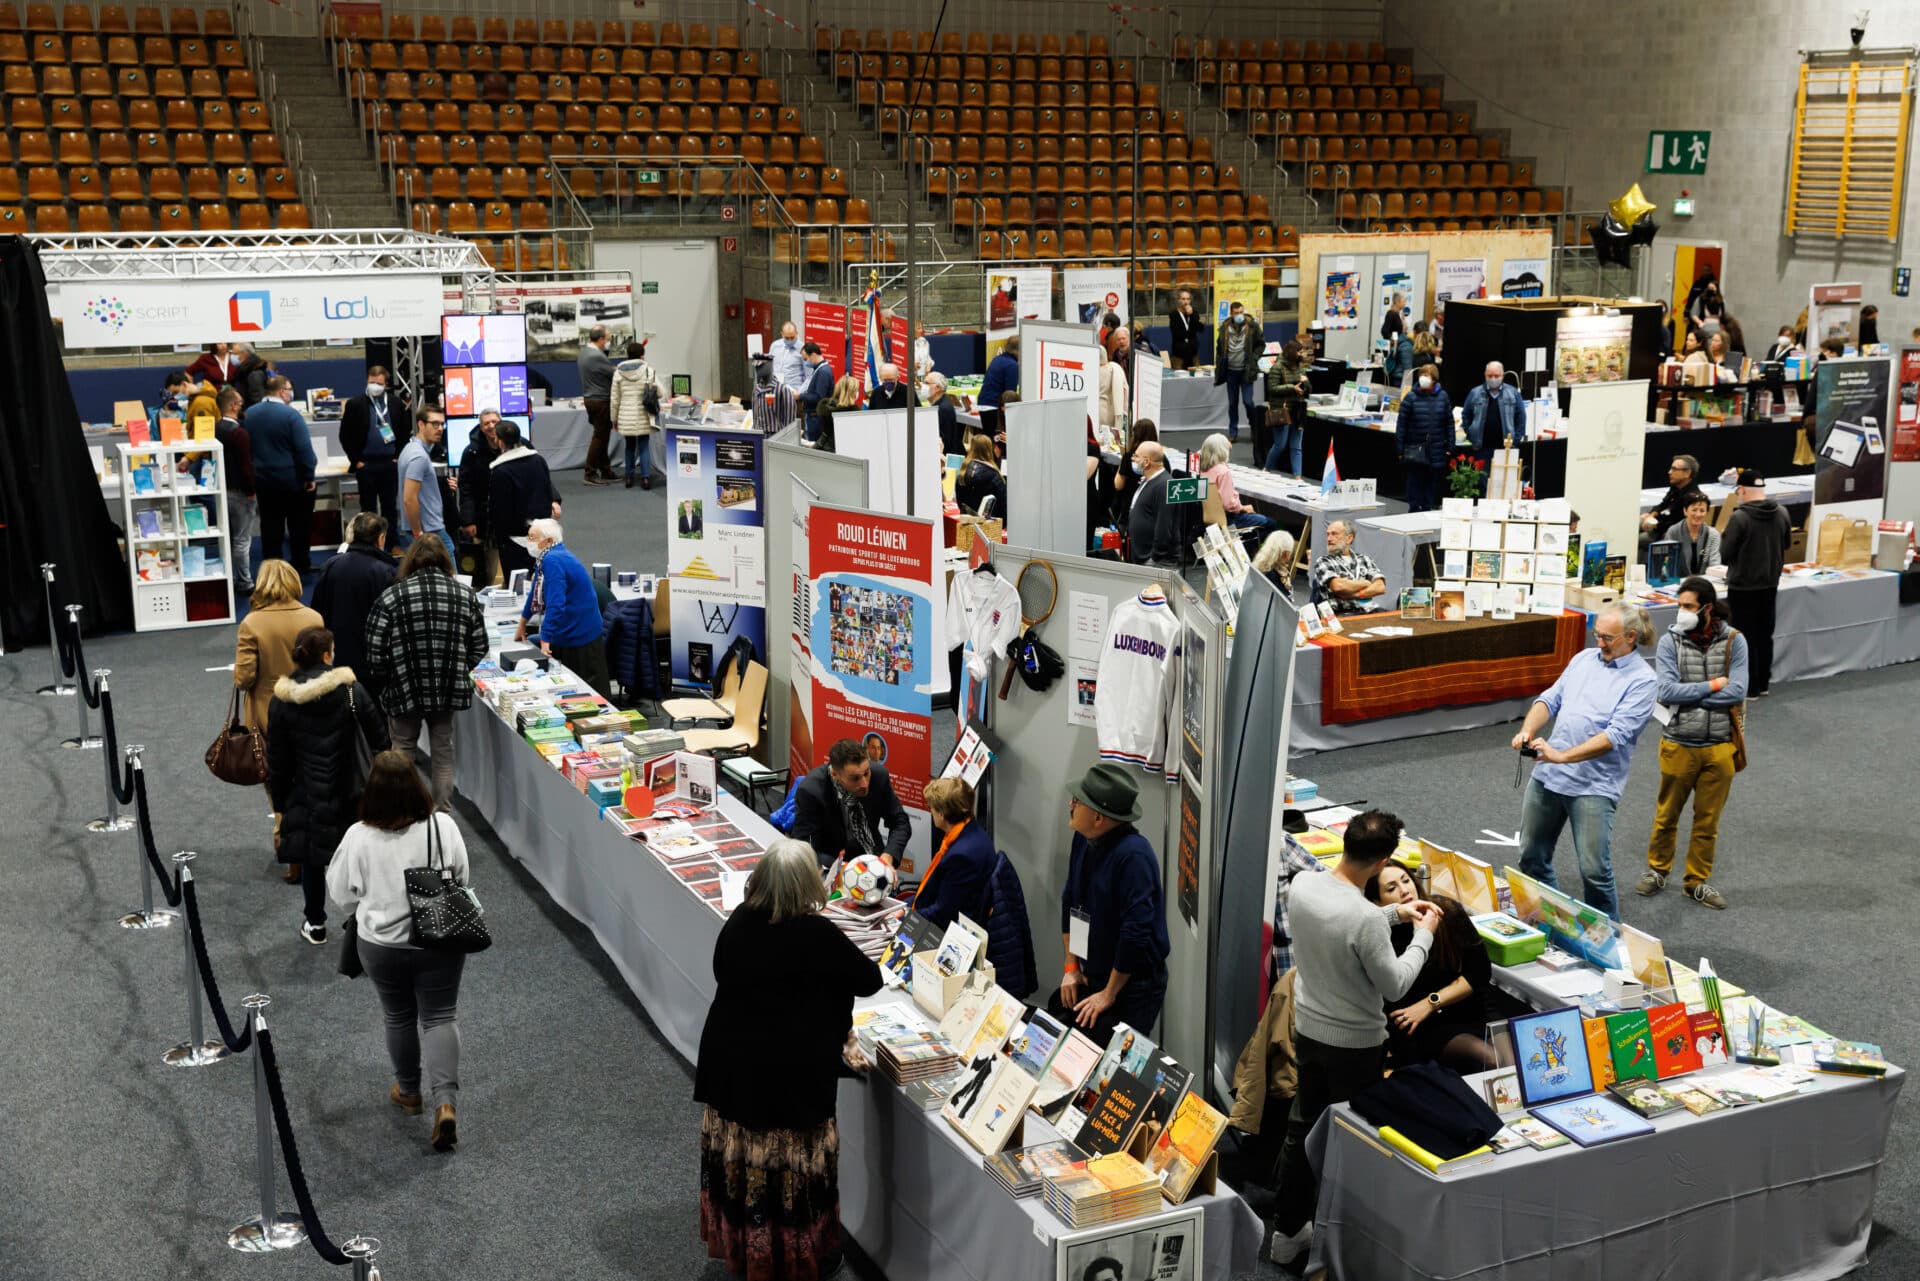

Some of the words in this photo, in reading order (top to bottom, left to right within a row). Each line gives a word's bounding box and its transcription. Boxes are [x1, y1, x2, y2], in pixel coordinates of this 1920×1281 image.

[136, 306, 190, 319] SCRIPT
[1050, 371, 1085, 392] BAD
[718, 529, 733, 537] Marc
[734, 529, 755, 538] Lindner
[837, 522, 865, 544] ROUD
[867, 525, 907, 551] LÉIWEN
[828, 544, 858, 556] PATRIMOINE
[887, 554, 920, 567] LUXEMBOURG
[845, 705, 855, 716] LES
[856, 707, 882, 721] EXPLOITS
[899, 719, 927, 733] CHAMPIONS
[874, 721, 903, 736] DISCIPLINES
[1103, 1098, 1131, 1121] BRANDY
[1110, 1089, 1137, 1111] ROBERT
[1099, 1110, 1117, 1127] FACE
[1090, 1117, 1121, 1143] LUI-MÊME
